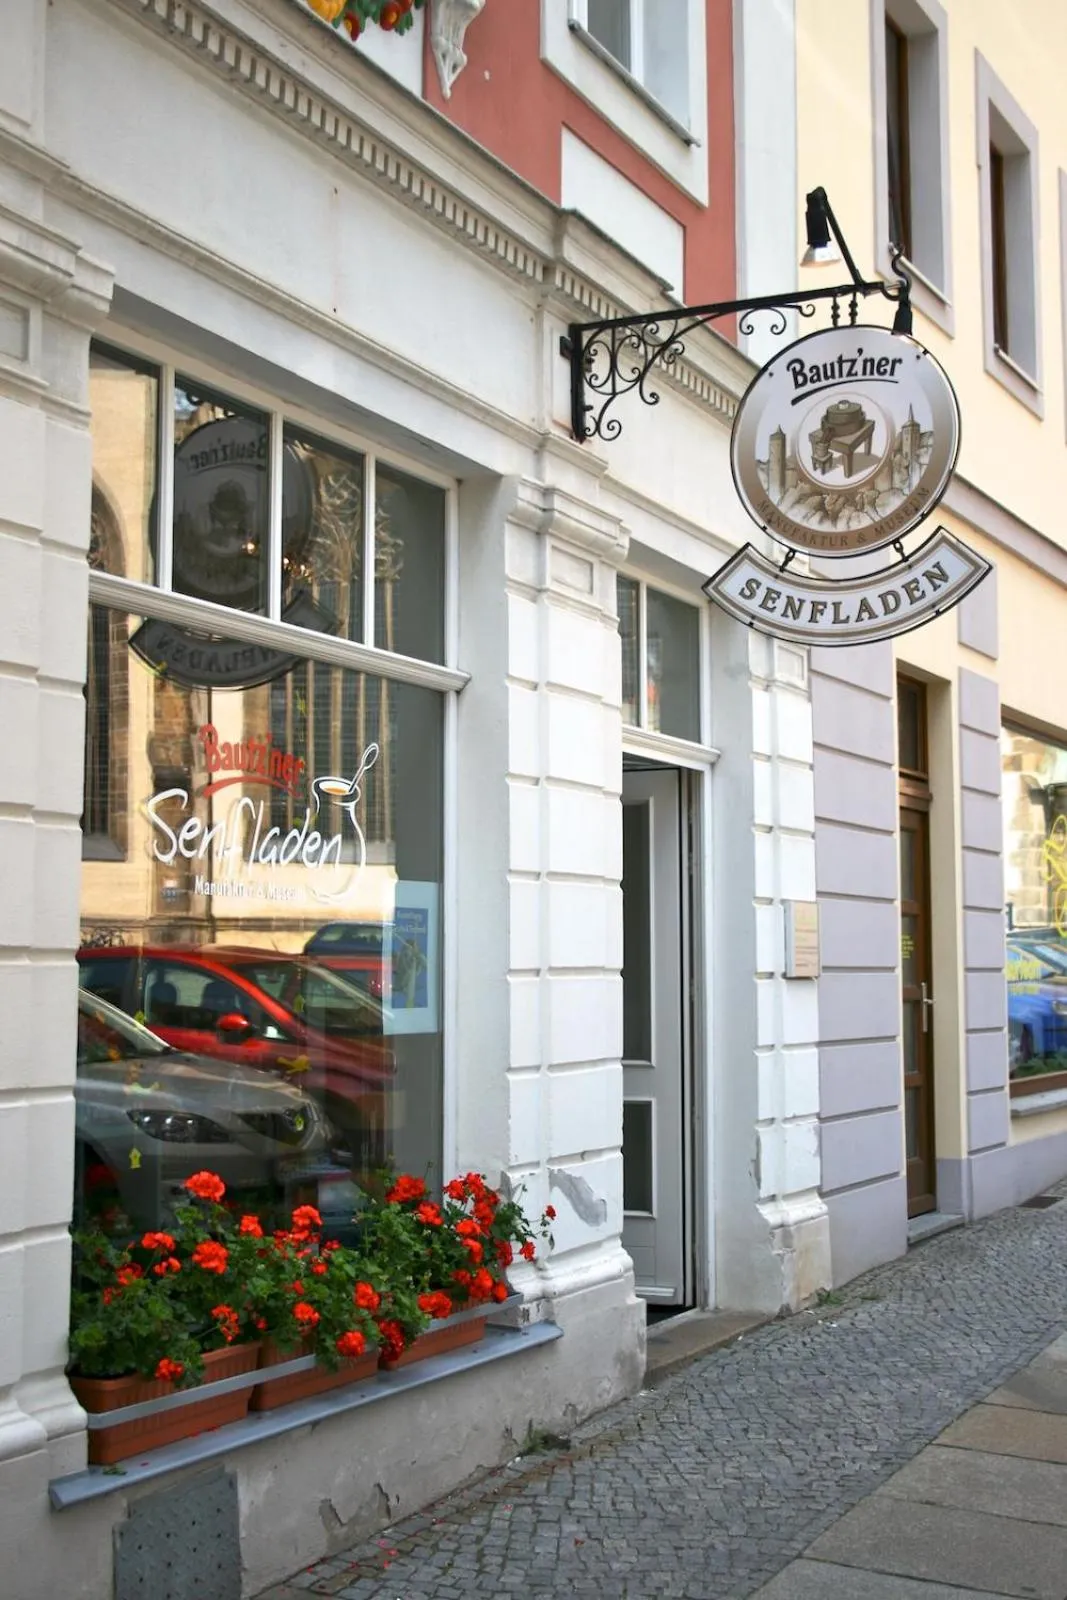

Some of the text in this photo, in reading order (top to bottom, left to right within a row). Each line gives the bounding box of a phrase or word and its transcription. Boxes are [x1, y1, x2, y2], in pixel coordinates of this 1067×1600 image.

[787, 348, 902, 389] Bautz'ner
[756, 487, 930, 546] MANUFAKTUR & MUSEUM
[739, 561, 950, 624] SENFLADEN
[199, 724, 304, 785] Bautz'ner
